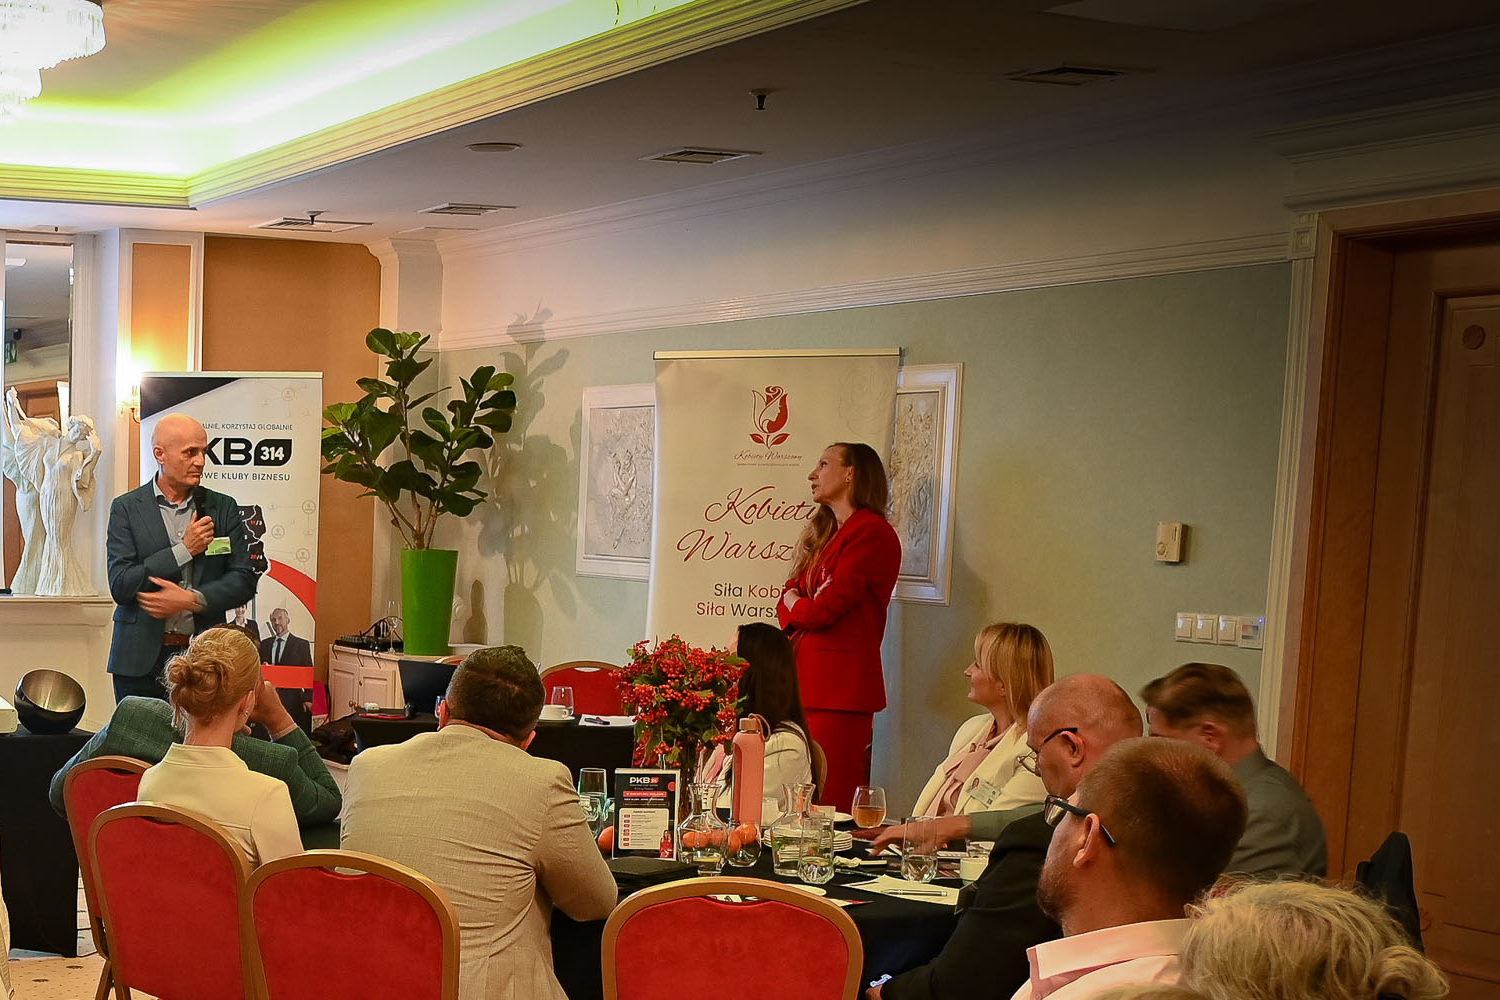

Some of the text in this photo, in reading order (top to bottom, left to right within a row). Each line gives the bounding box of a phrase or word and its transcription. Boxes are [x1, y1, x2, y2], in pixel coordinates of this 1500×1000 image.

[260, 446, 284, 461] 314
[222, 472, 249, 480] KLUBY
[252, 473, 290, 481] BIZNESU
[677, 529, 794, 562] Warsz
[714, 583, 742, 598] Siła
[696, 601, 725, 616] Siła
